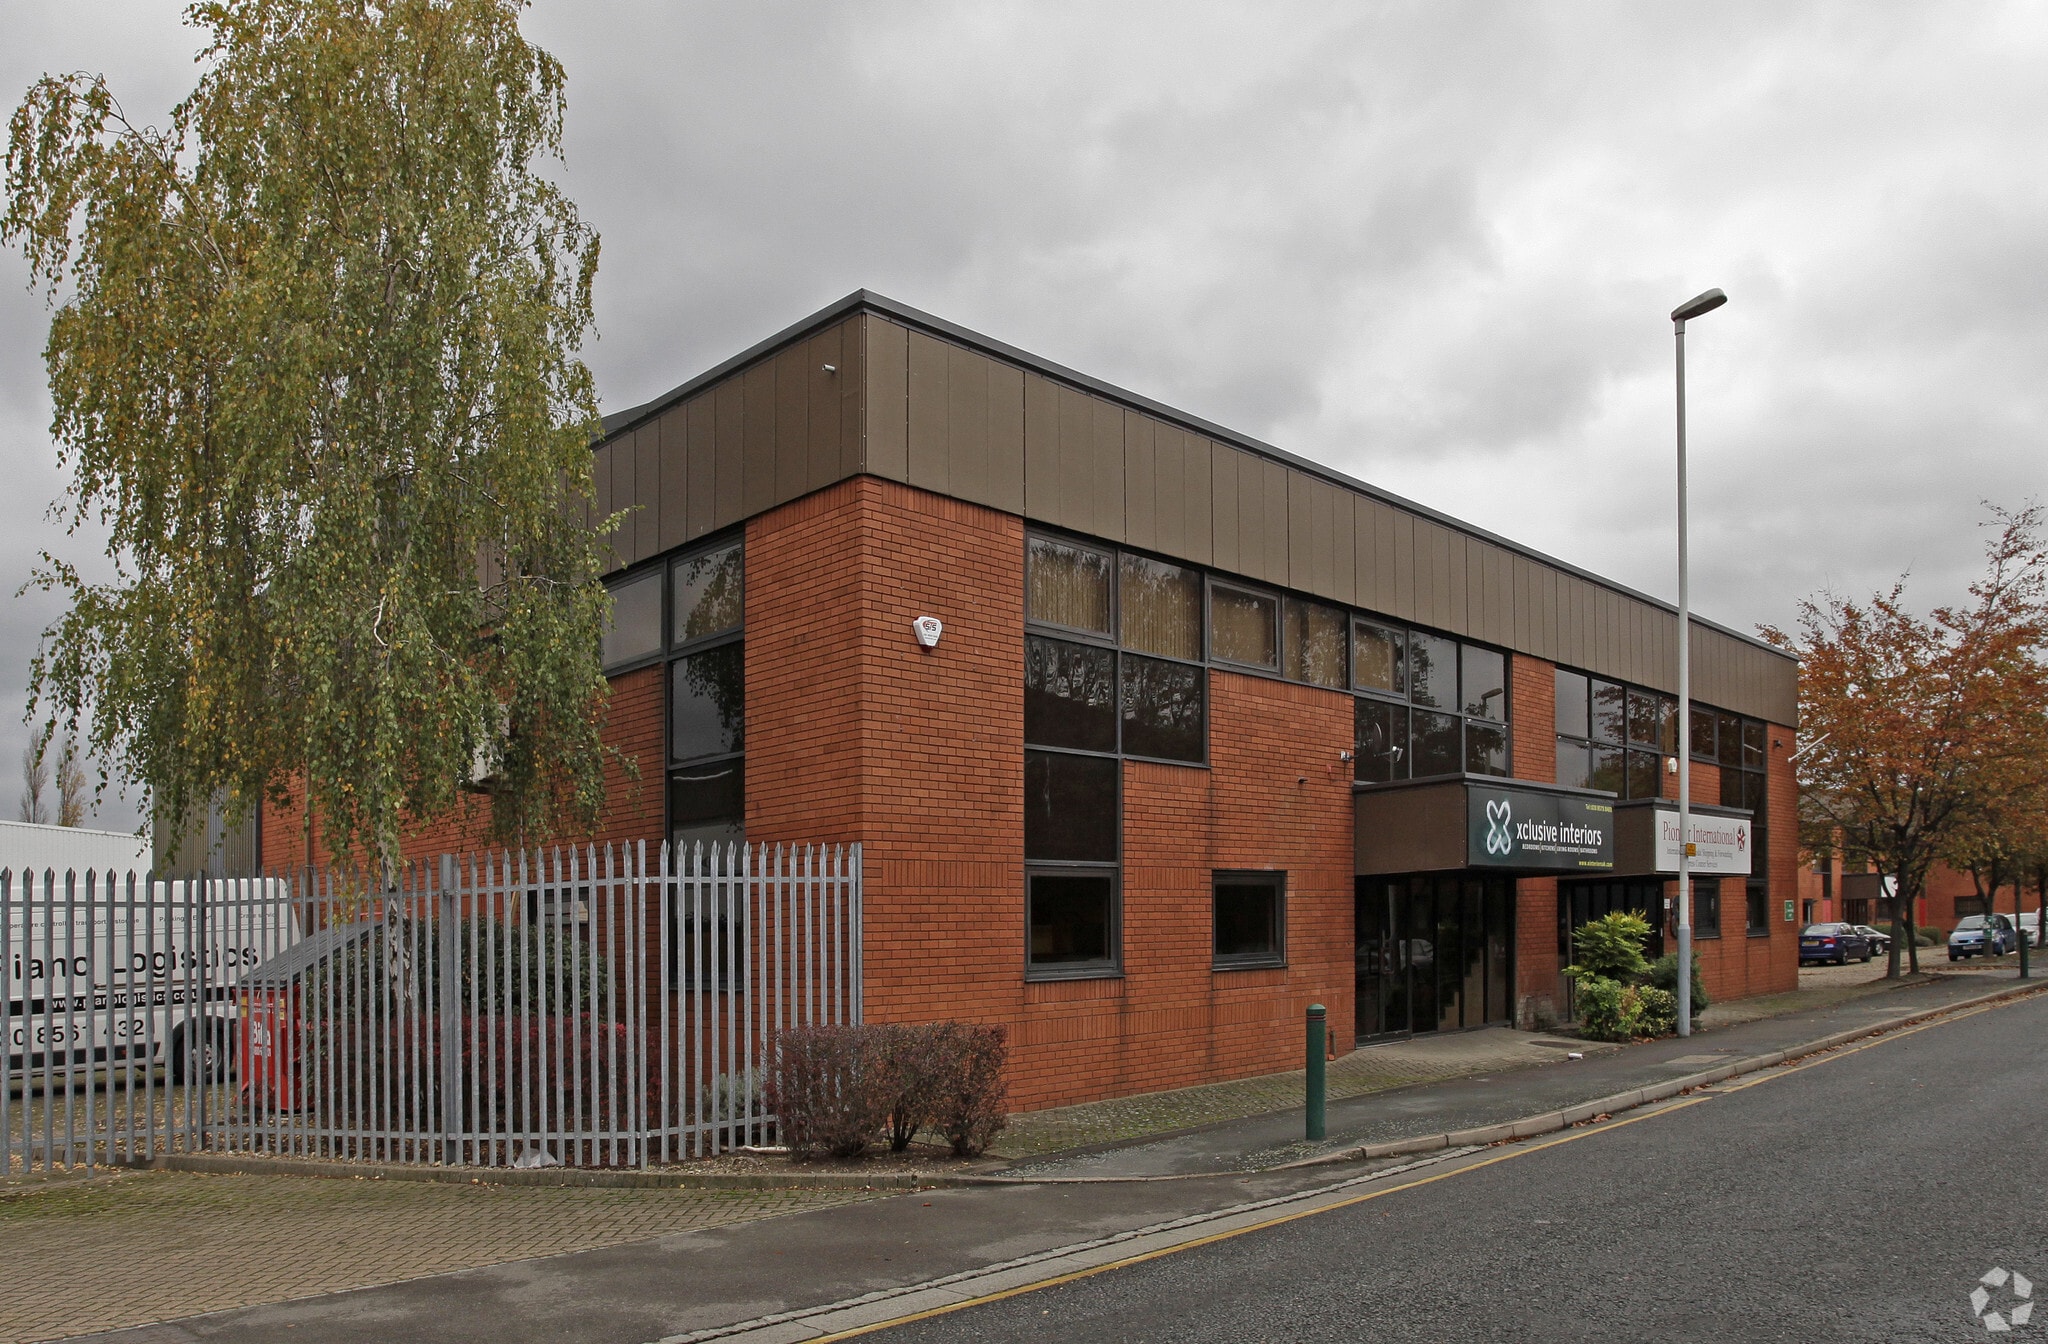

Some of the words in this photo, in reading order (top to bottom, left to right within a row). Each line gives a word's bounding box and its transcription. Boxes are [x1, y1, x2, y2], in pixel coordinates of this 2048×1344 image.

[1560, 820, 1602, 846] interiors
[1663, 820, 1692, 842] Pionr
[1693, 823, 1736, 846] International
